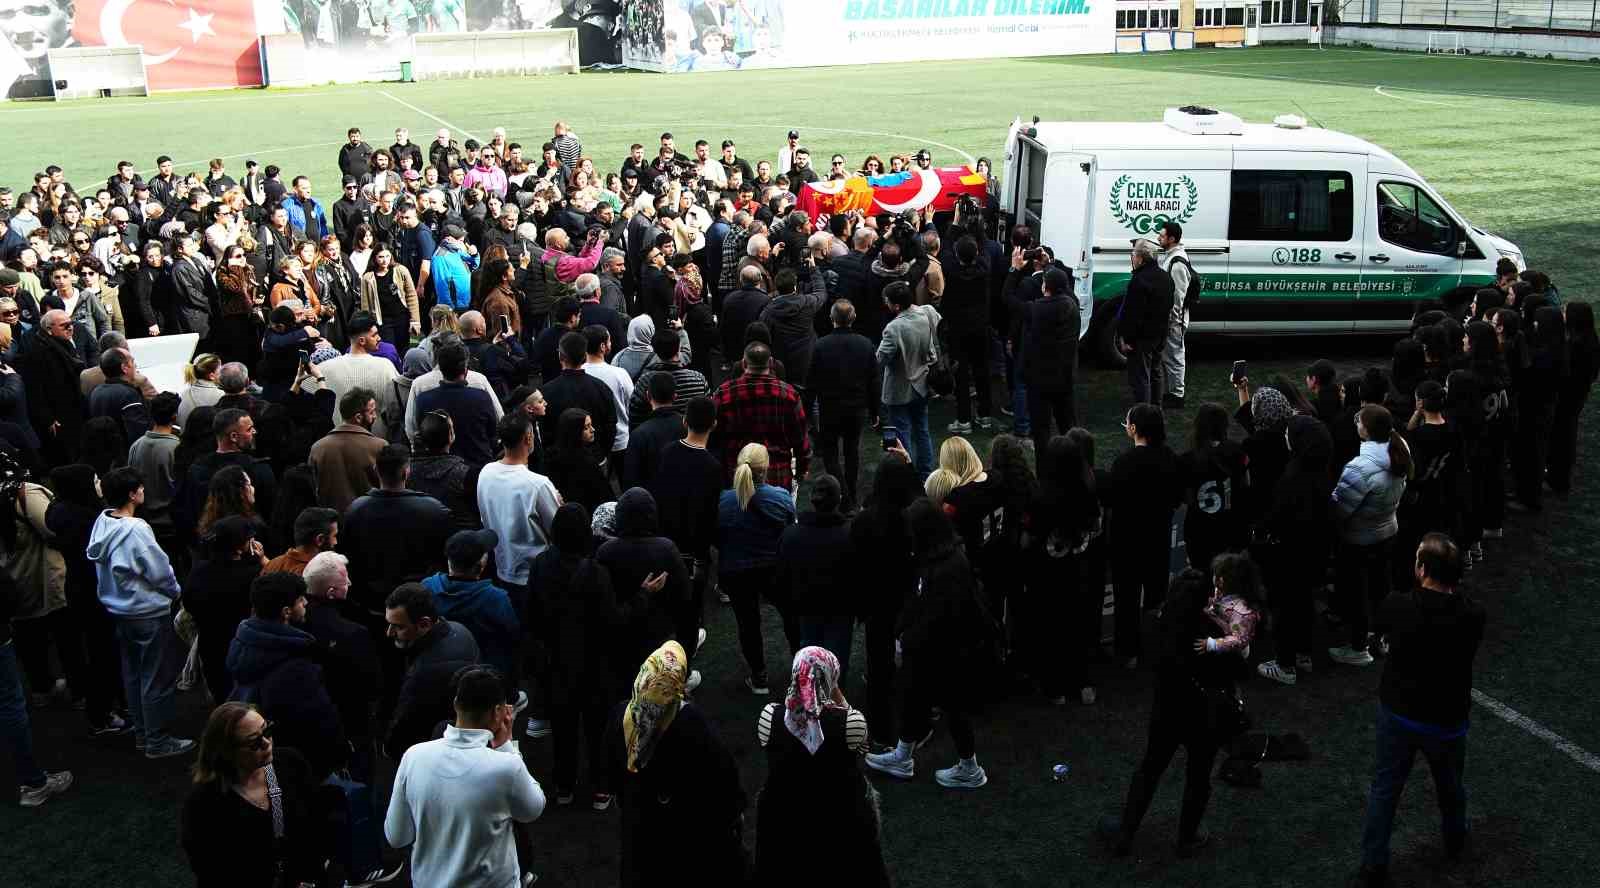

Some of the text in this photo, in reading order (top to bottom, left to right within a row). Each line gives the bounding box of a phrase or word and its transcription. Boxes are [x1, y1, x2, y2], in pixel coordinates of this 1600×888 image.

[1127, 182, 1181, 199] CENAZE
[1126, 199, 1181, 211] NAKİL ARACI
[1291, 248, 1322, 262] 188
[1214, 279, 1396, 293] BURSA BÜYÜKŞEHİR BELEDİYESİ
[1197, 477, 1231, 514] 61
